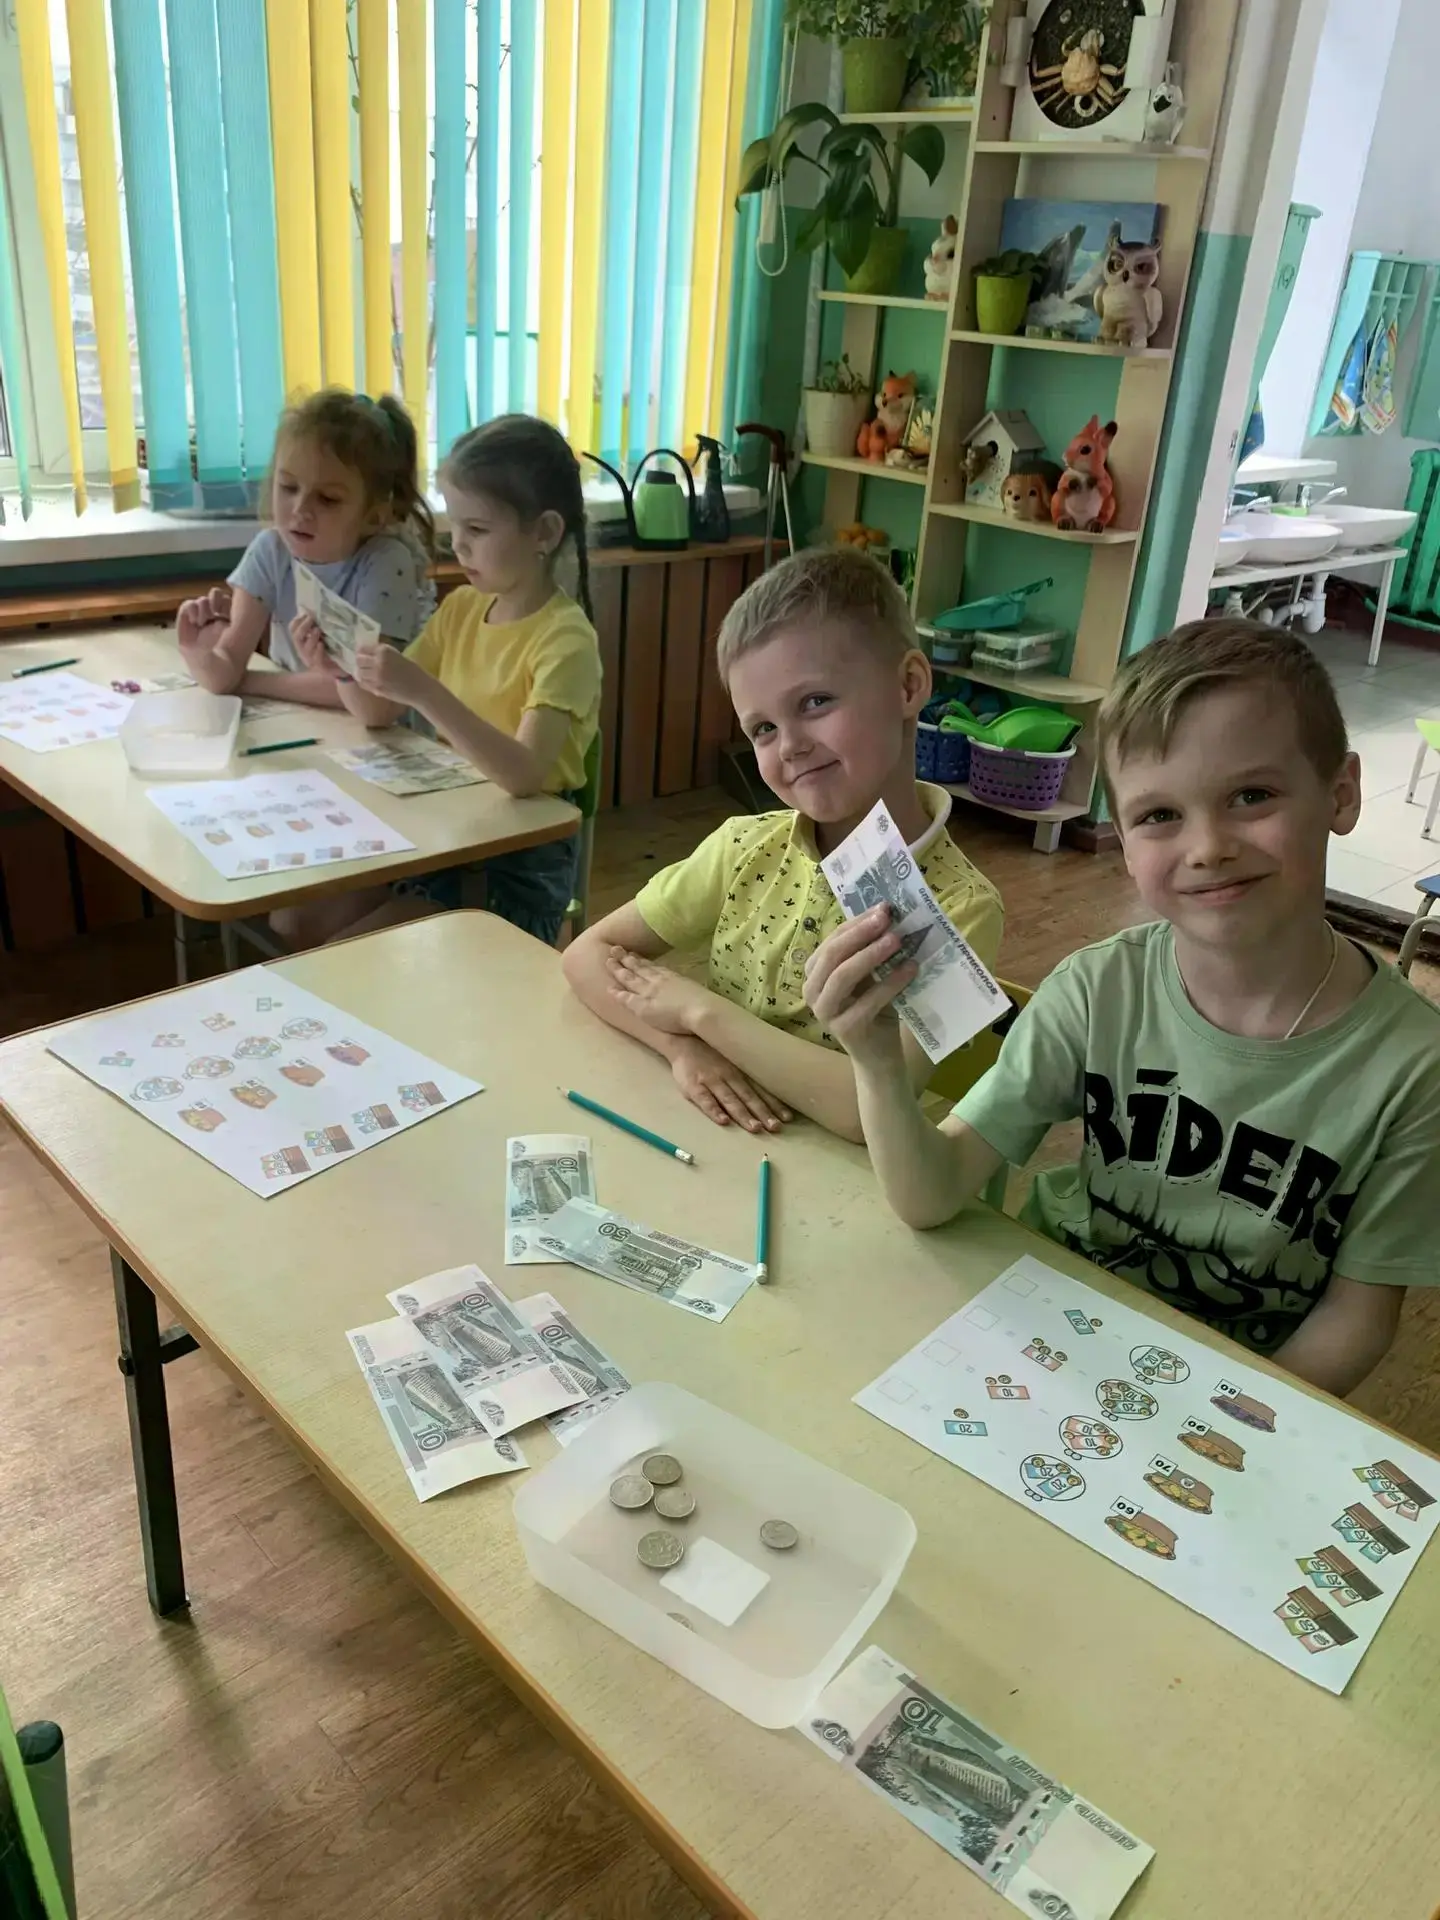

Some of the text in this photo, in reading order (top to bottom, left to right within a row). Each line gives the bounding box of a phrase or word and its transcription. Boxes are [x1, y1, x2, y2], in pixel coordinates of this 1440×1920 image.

[891, 849, 913, 881] 10
[957, 942, 999, 996] ПРИКОЛОВ
[556, 1156, 579, 1173] 10
[597, 1222, 632, 1242] 50
[461, 1292, 494, 1316] 10
[1072, 1317, 1087, 1327] 20
[540, 1325, 574, 1346] 10
[1035, 1353, 1049, 1363] 10
[1002, 1388, 1015, 1397] 10
[1126, 1391, 1138, 1400] 10
[1220, 1383, 1237, 1396] 80
[1123, 1403, 1136, 1412] 20
[959, 1423, 973, 1433] 20
[1082, 1424, 1094, 1435] 10
[1187, 1419, 1207, 1433] 90
[413, 1423, 446, 1452] 10
[1085, 1438, 1097, 1448] 10
[1040, 1466, 1054, 1477] 20
[1155, 1459, 1171, 1473] 70
[1051, 1479, 1066, 1491] 20
[1380, 1480, 1395, 1491] 20
[1116, 1501, 1135, 1515] 60
[1311, 1560, 1329, 1571] 50
[1326, 1574, 1341, 1586] 20
[900, 1696, 945, 1736] 10
